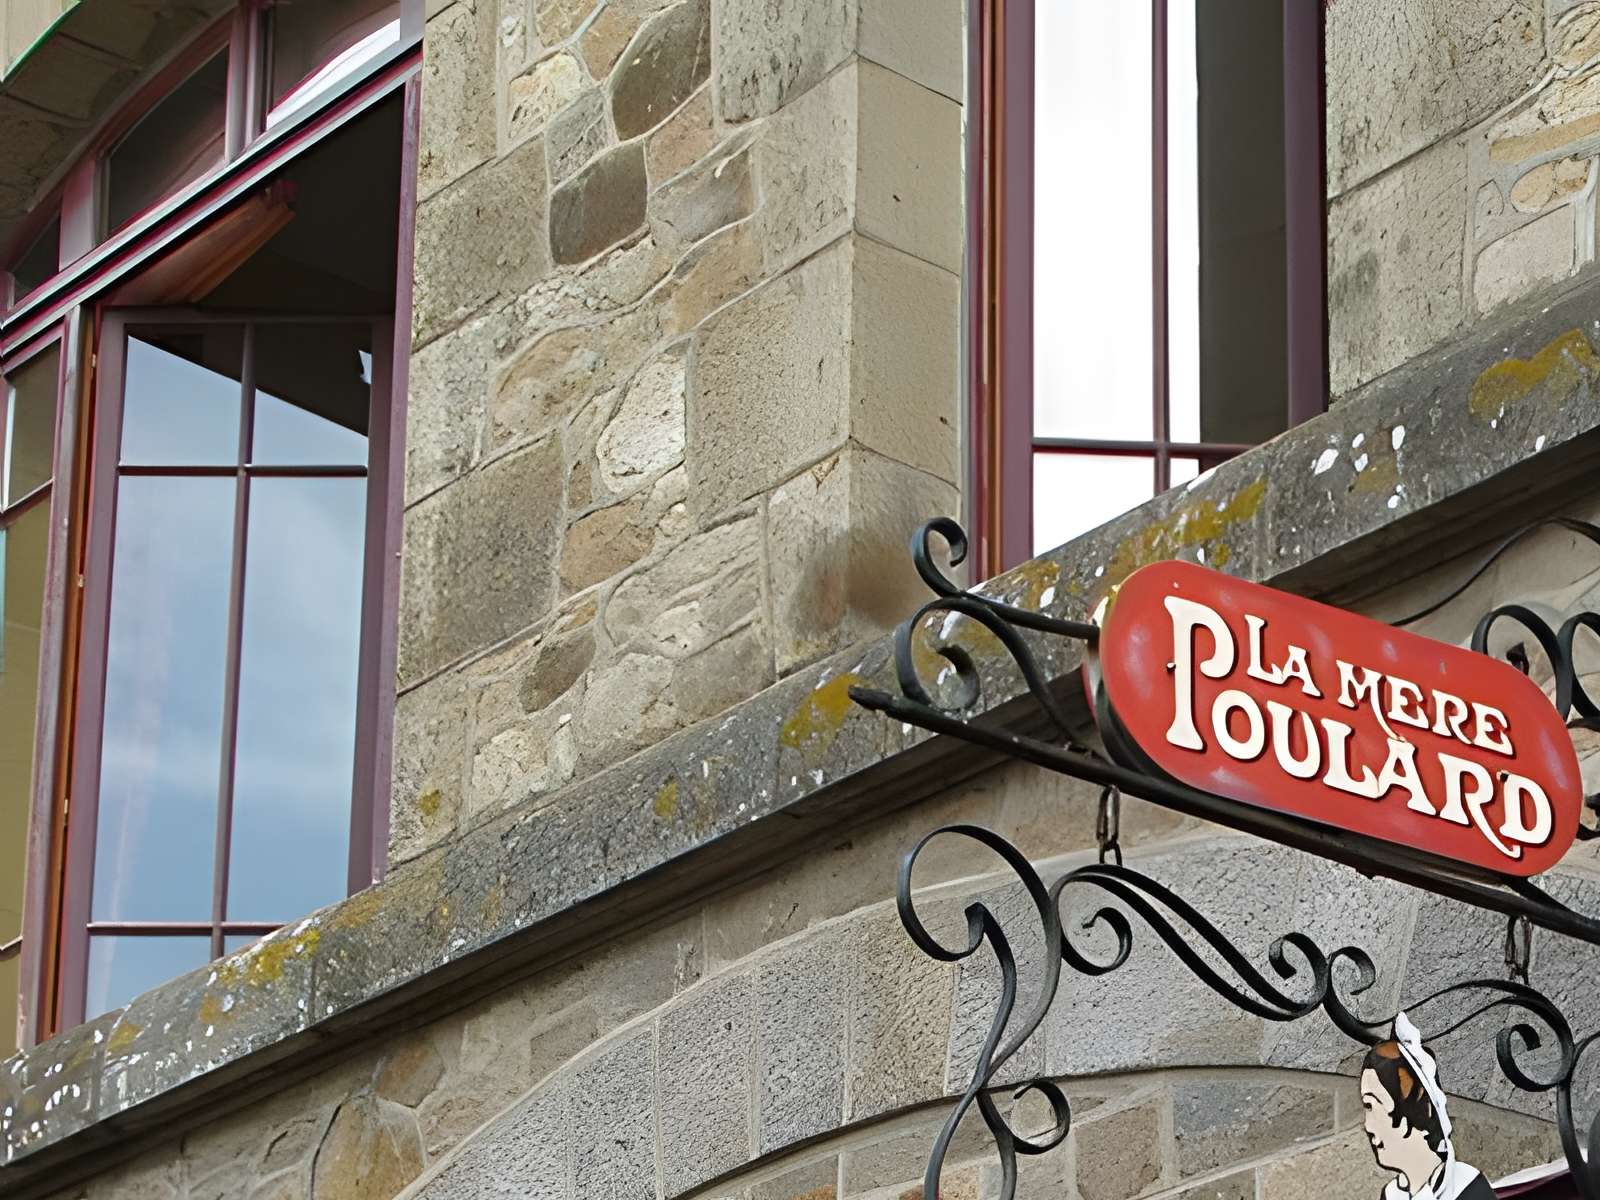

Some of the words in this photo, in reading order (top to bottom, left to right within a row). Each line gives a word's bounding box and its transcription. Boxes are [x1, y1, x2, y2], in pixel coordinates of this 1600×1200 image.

[1163, 595, 1553, 859] POULARD
[1244, 614, 1323, 697] LA
[1335, 659, 1514, 756] MERE
